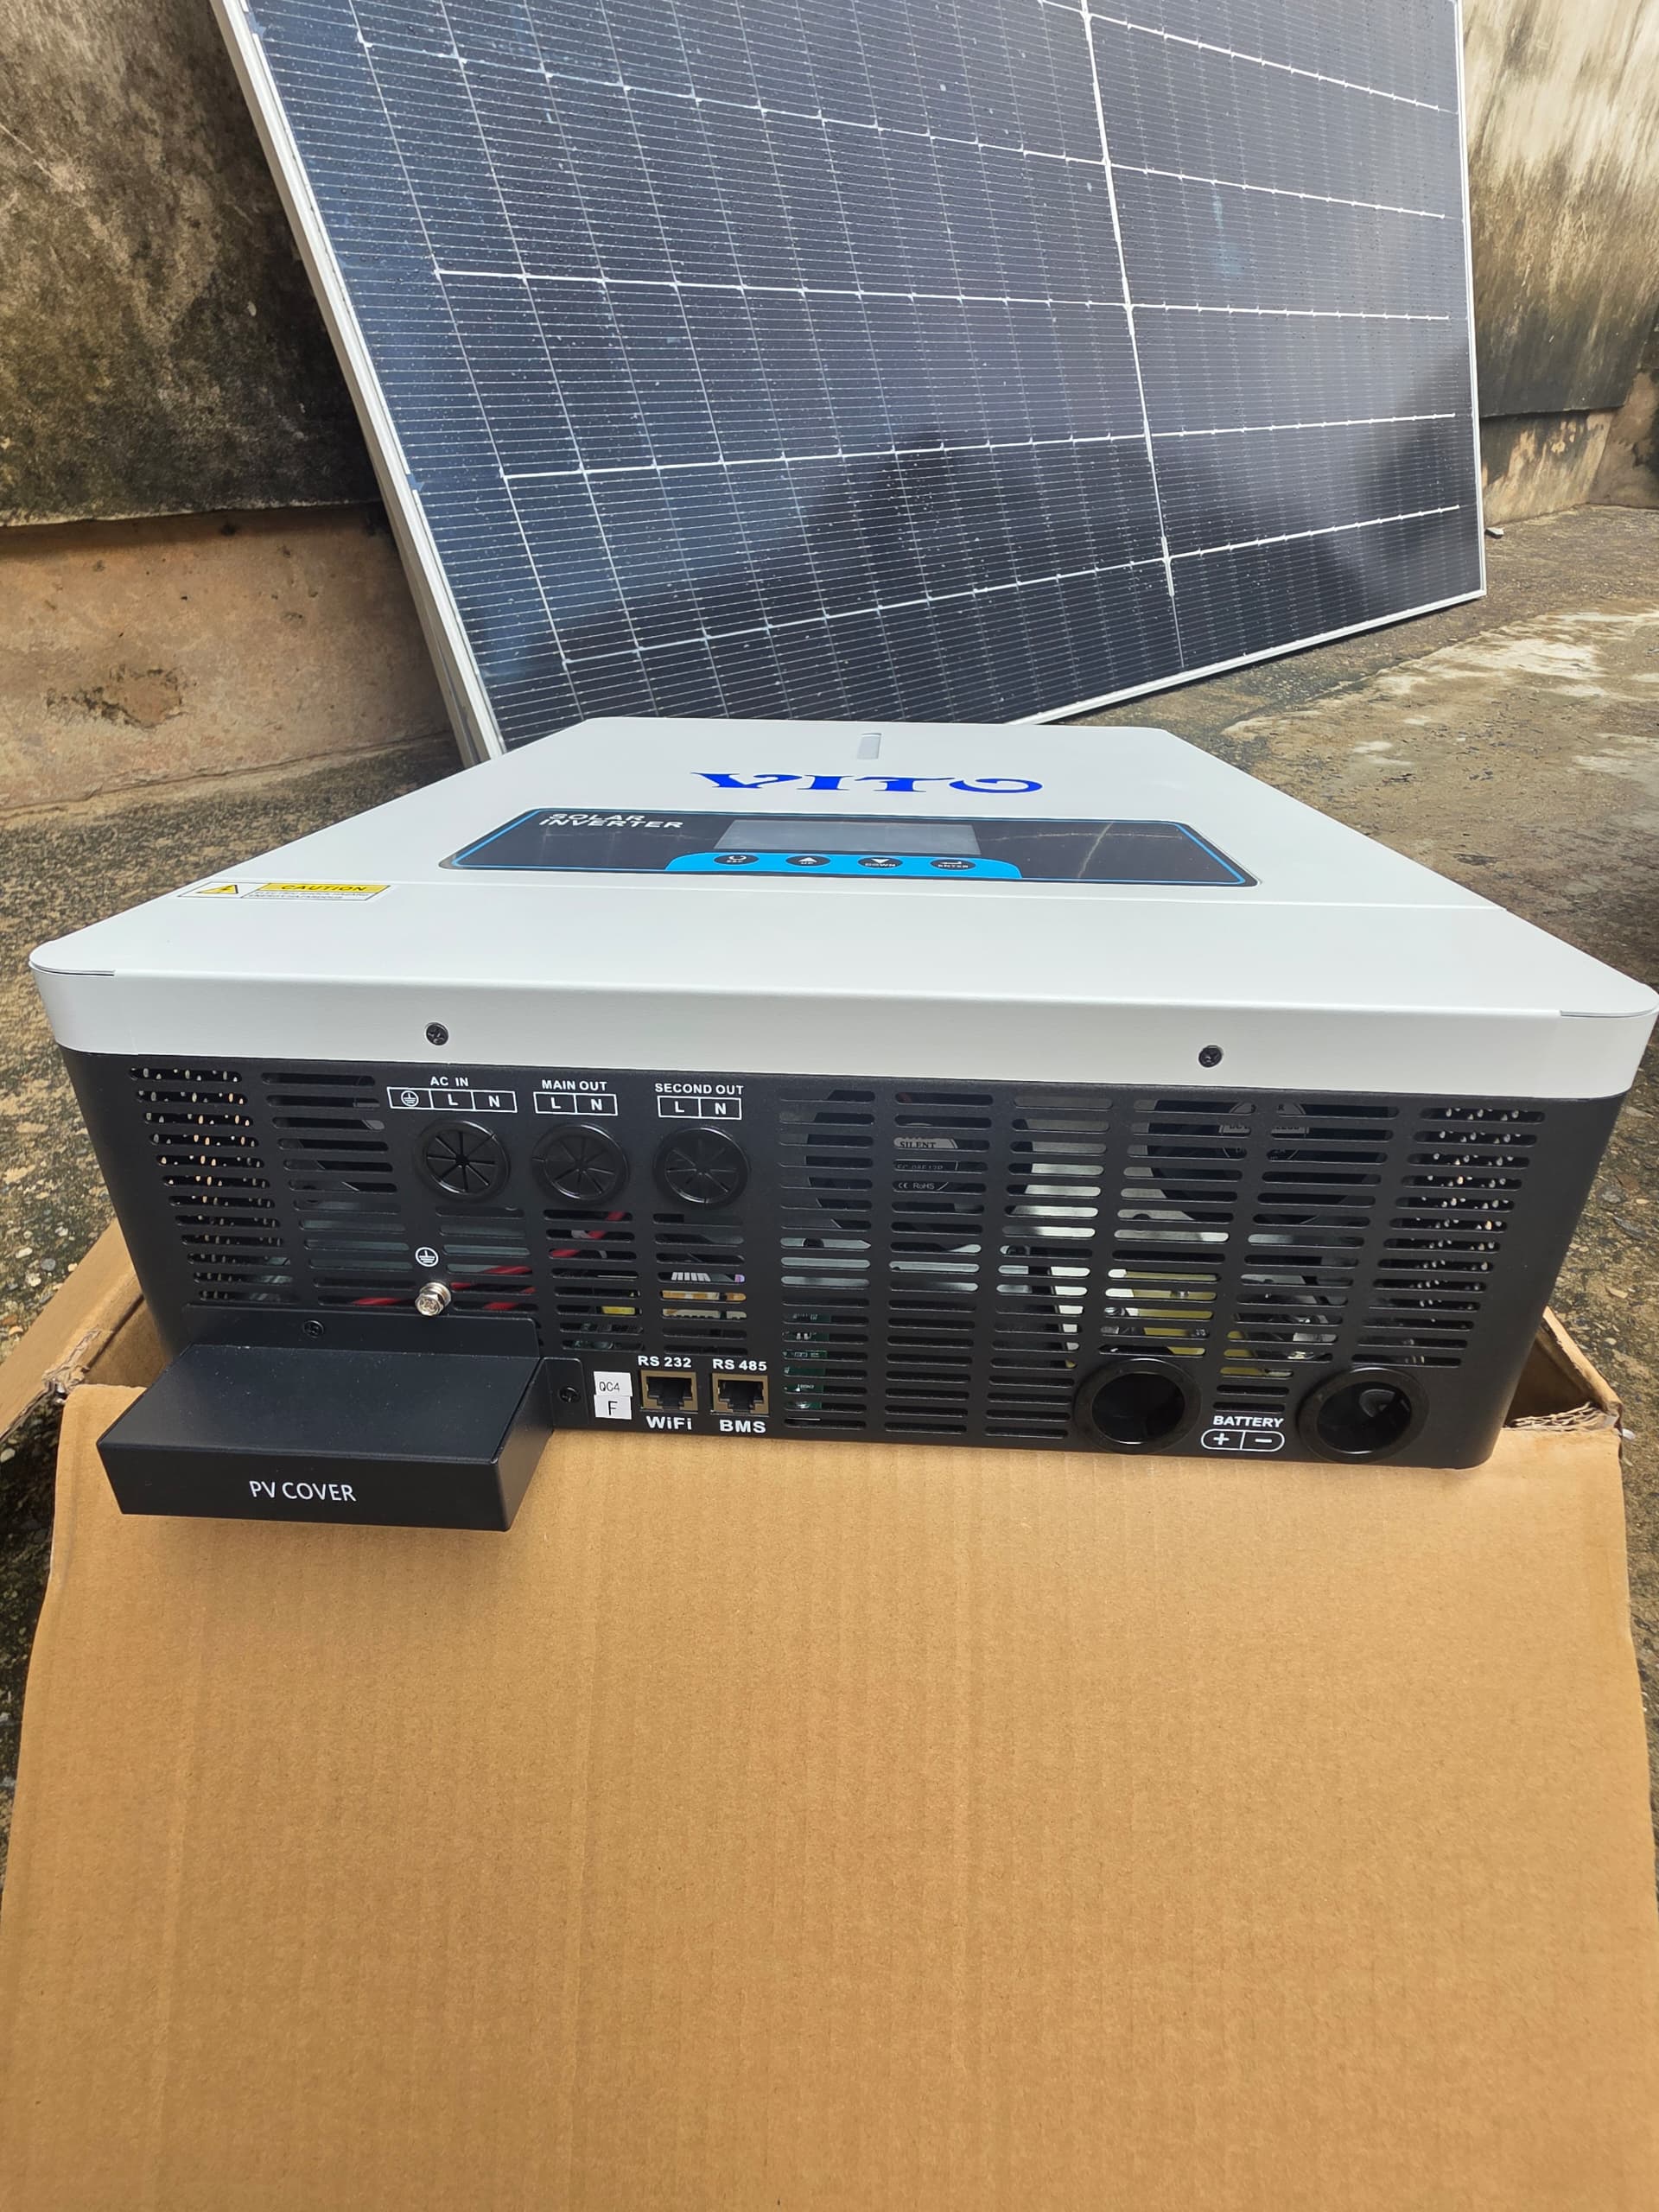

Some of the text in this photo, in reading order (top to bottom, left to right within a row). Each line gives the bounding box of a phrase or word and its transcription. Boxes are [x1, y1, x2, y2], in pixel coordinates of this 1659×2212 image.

[690, 772, 1043, 793] VITO
[539, 819, 683, 828] INVERTER
[430, 1076, 469, 1087] AC IN
[542, 1079, 607, 1091] MAIN OUT
[654, 1083, 744, 1095] SECOND OUT
[448, 1093, 500, 1108] L N
[550, 1096, 603, 1111] L N
[674, 1100, 727, 1115] L N
[638, 1355, 692, 1368] RS 232
[712, 1358, 767, 1371] RS 485
[599, 1381, 620, 1392] QC4
[607, 1401, 619, 1415] F
[645, 1415, 692, 1430] WiFi
[719, 1419, 766, 1433] BMS
[1212, 1415, 1284, 1427] BATTERY
[249, 1480, 357, 1502] PV COVER
